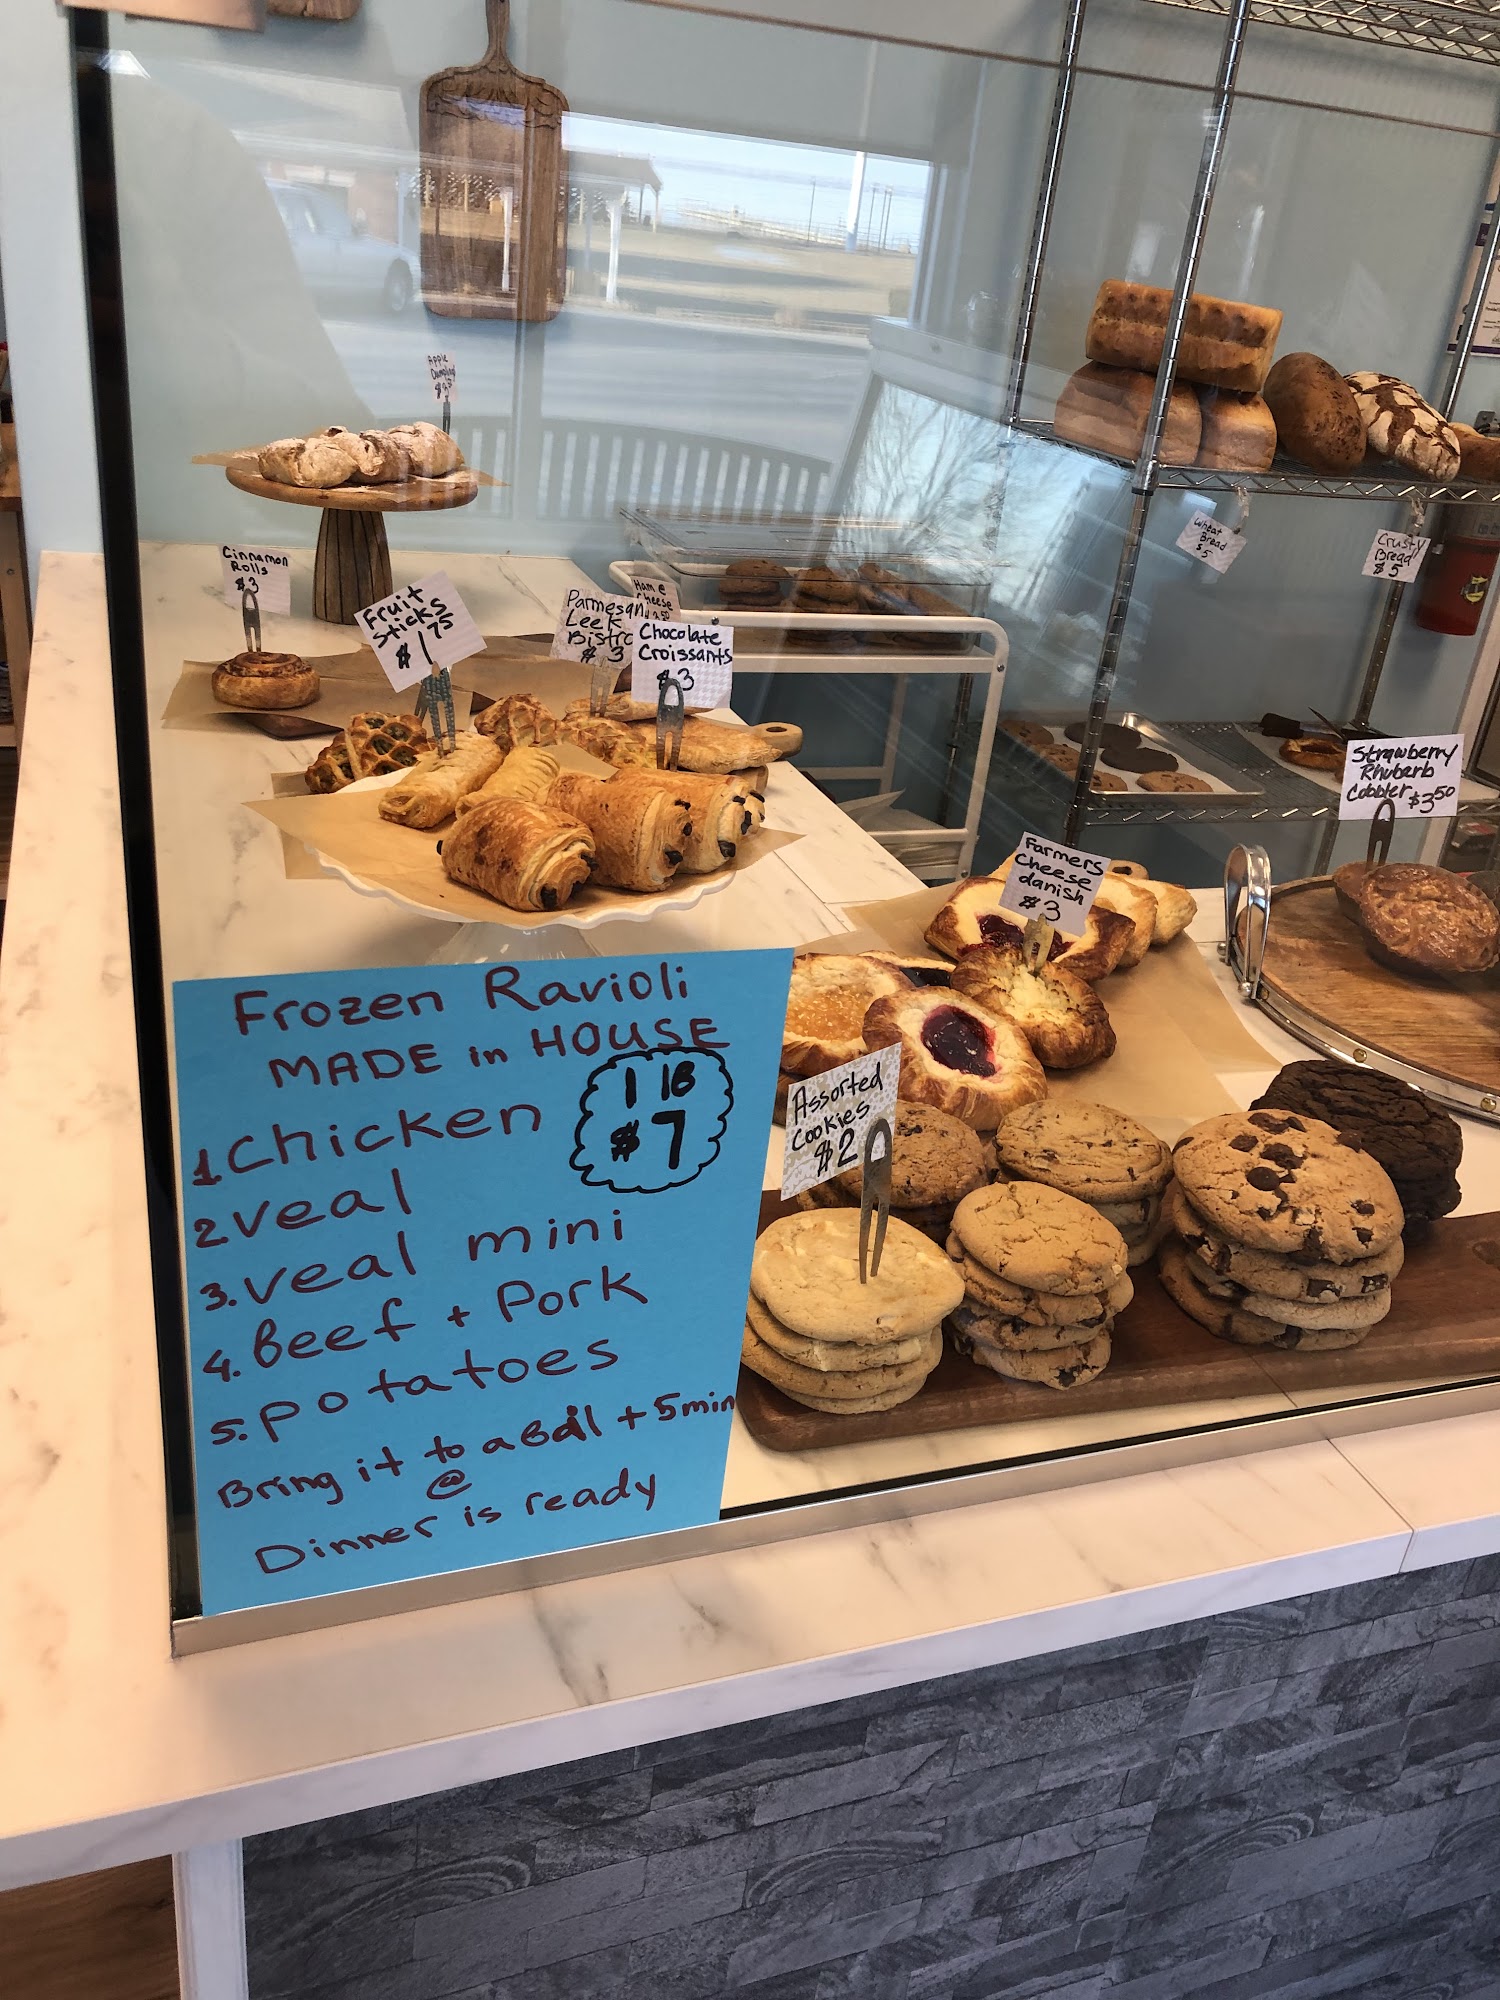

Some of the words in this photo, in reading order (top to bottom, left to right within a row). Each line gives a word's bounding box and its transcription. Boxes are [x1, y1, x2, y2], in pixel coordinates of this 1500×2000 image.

[1193, 517, 1222, 536] Wheat
[1200, 531, 1228, 551] Bread
[222, 545, 289, 567] Cinnamon
[1374, 548, 1418, 567] Bread
[1377, 532, 1426, 559] Crusty
[230, 560, 268, 575] Rolls
[633, 579, 656, 593] Ham
[363, 586, 423, 630] Fruit
[567, 589, 645, 620] Parmesan
[565, 609, 622, 632] Leek
[639, 622, 722, 646] Chocolate
[638, 644, 733, 666] Croissants
[1351, 743, 1459, 768] Strawberry
[1346, 782, 1413, 802] Cobbler
[1025, 837, 1104, 877] Farmers
[1019, 872, 1084, 905] danish
[233, 990, 444, 1036] Frozen
[485, 962, 688, 1012] Ravioli
[268, 1044, 442, 1089] MADE
[469, 1046, 508, 1068] in
[531, 1017, 731, 1059] HOUSE
[792, 1061, 884, 1126] Assorted
[791, 1100, 871, 1152] Cookies
[814, 1128, 859, 1177] $2
[468, 1210, 623, 1261] mini
[218, 1473, 343, 1508] Bring
[357, 1446, 403, 1482] it
[424, 1436, 465, 1463] to
[255, 1516, 437, 1573] Dinner
[464, 1506, 501, 1527] is
[526, 1468, 656, 1515] ready
